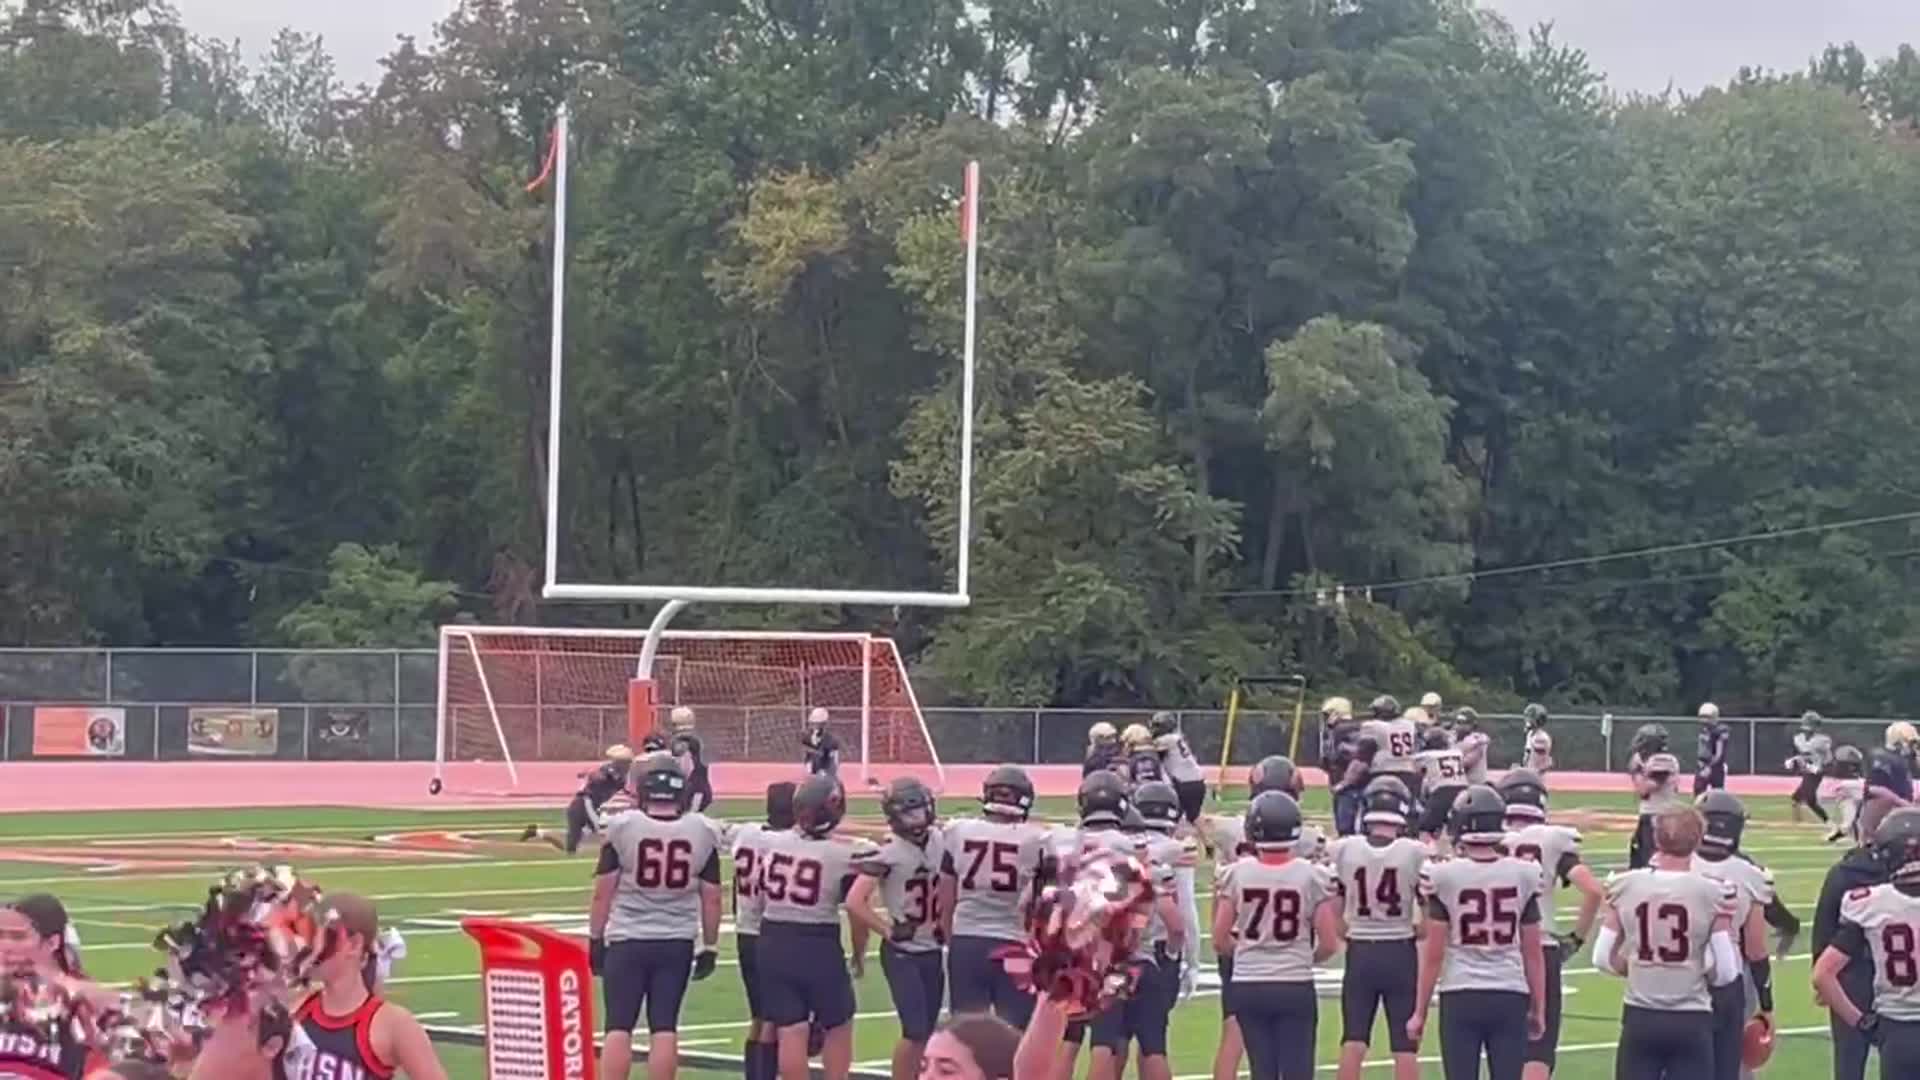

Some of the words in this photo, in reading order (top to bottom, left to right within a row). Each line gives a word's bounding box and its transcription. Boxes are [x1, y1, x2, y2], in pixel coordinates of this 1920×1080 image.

[1390, 732, 1412, 756] 69
[637, 838, 692, 889] 66
[735, 848, 765, 897] 2
[768, 853, 822, 906] 59
[962, 840, 1019, 892] 75
[1243, 889, 1301, 941] 78
[1354, 867, 1402, 916] 14
[1459, 887, 1518, 945] 25
[1635, 902, 1690, 963] 13
